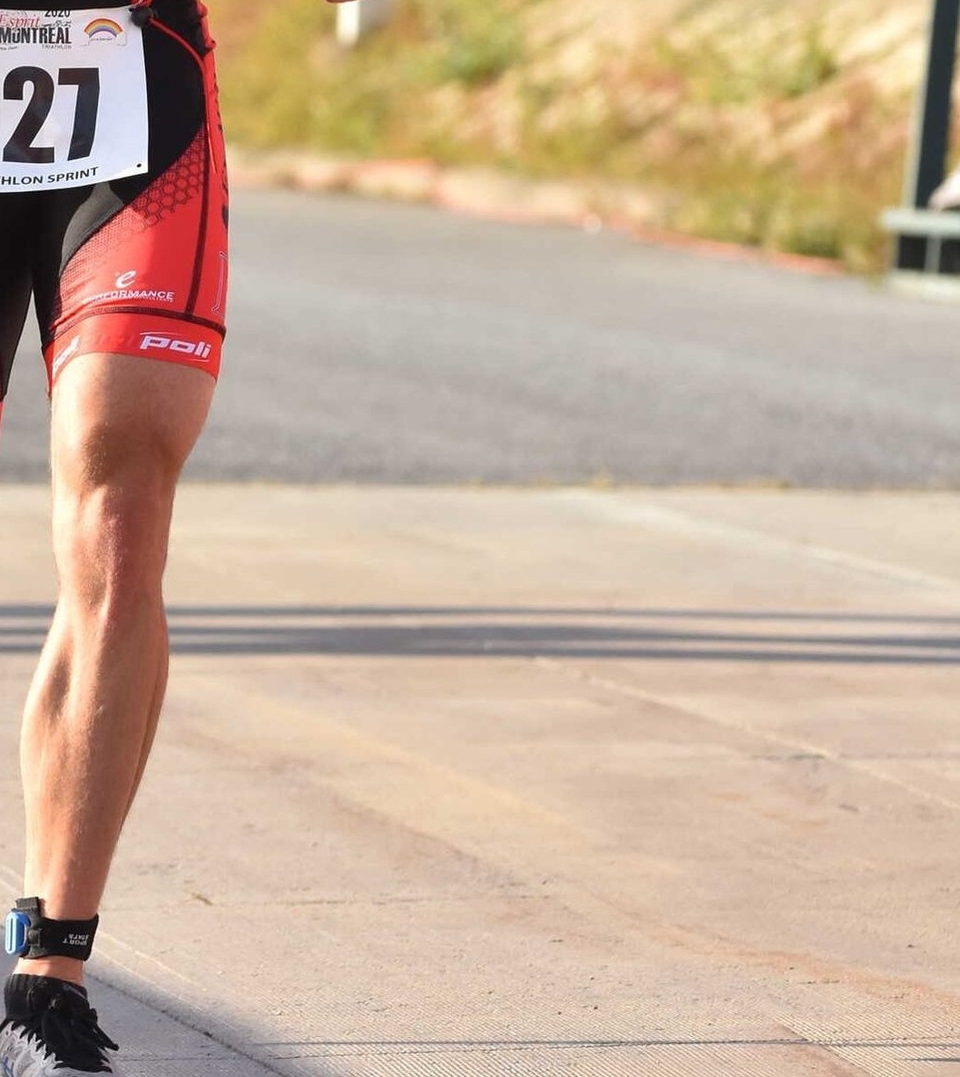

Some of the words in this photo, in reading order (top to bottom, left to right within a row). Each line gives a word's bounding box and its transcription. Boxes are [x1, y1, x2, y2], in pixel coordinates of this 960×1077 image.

[44, 9, 71, 18] 2020
[47, 166, 99, 184] SPRINT
[140, 335, 212, 359] poli
